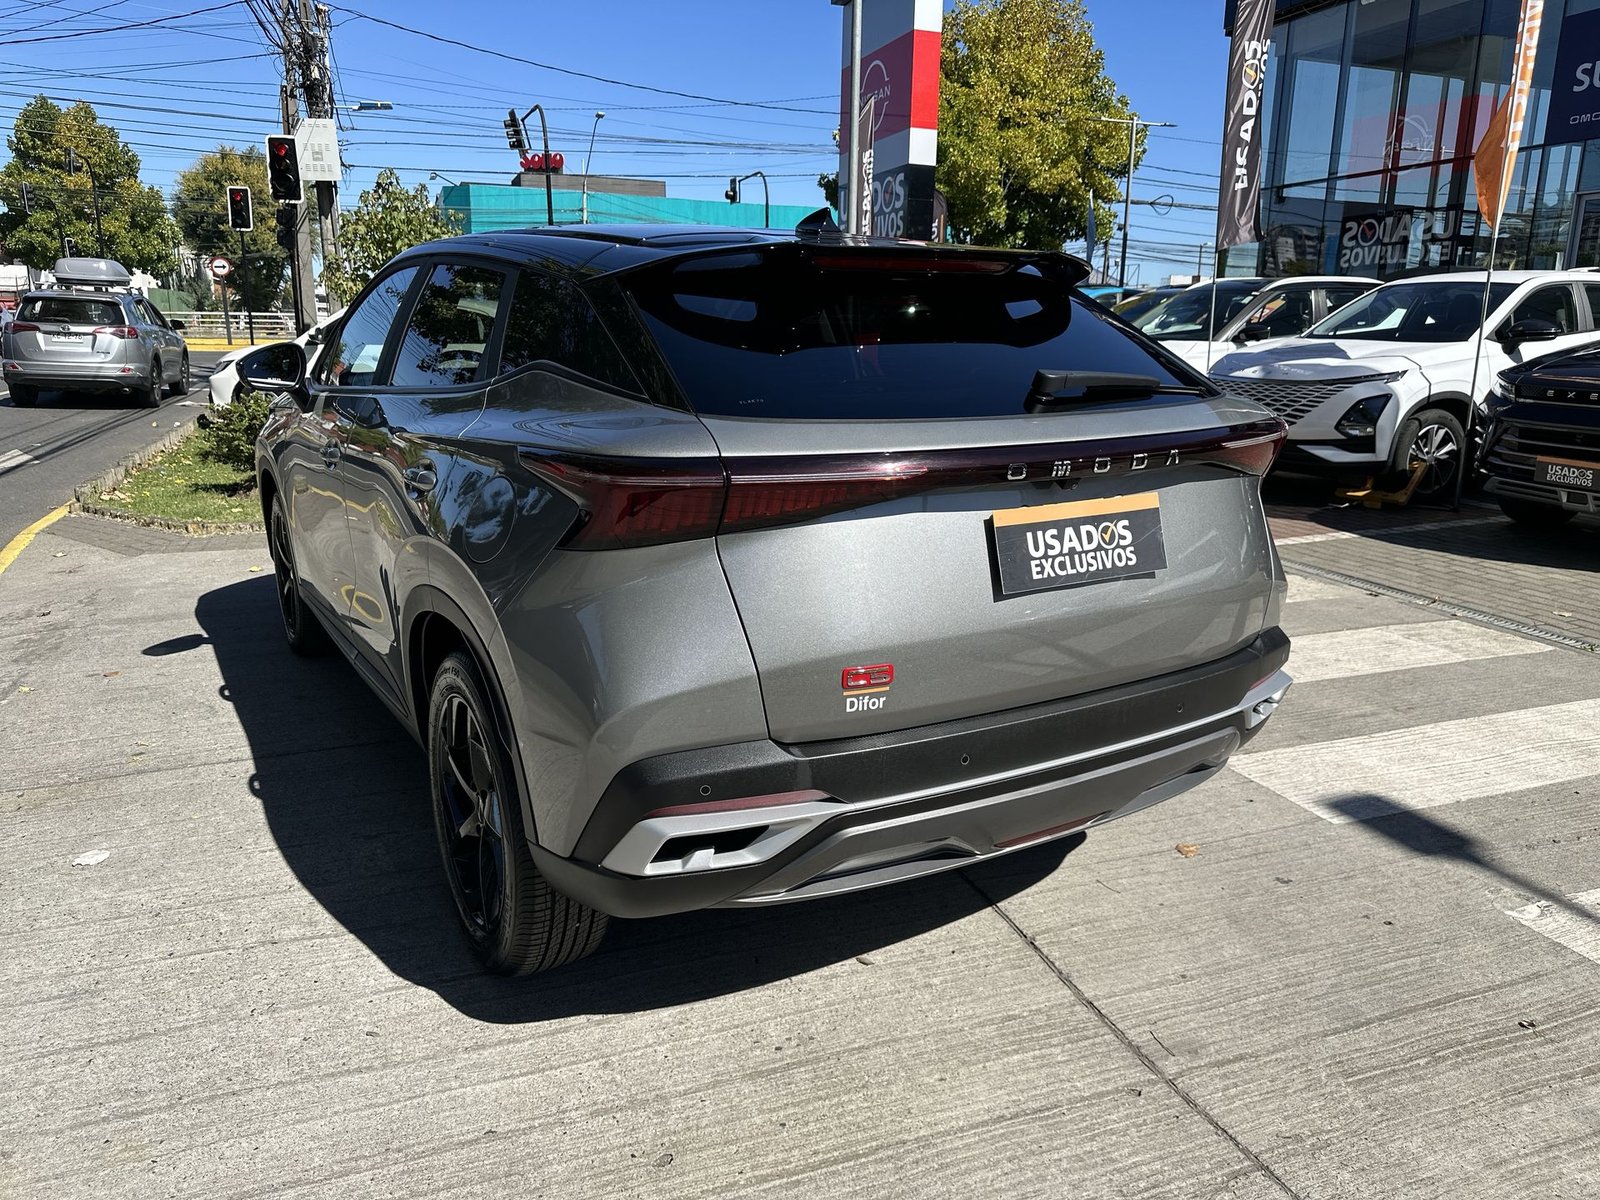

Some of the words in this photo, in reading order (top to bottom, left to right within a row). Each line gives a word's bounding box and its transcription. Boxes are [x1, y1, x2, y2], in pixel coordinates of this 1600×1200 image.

[840, 172, 905, 222] UDOS
[1007, 449, 1180, 481] OMODA
[1546, 473, 1593, 487] EXCLUSIVOS
[1548, 464, 1593, 480] USADOS
[1026, 519, 1133, 558] USADOS
[1030, 546, 1137, 580] EXCLUSIVOS
[846, 696, 886, 712] Difor
